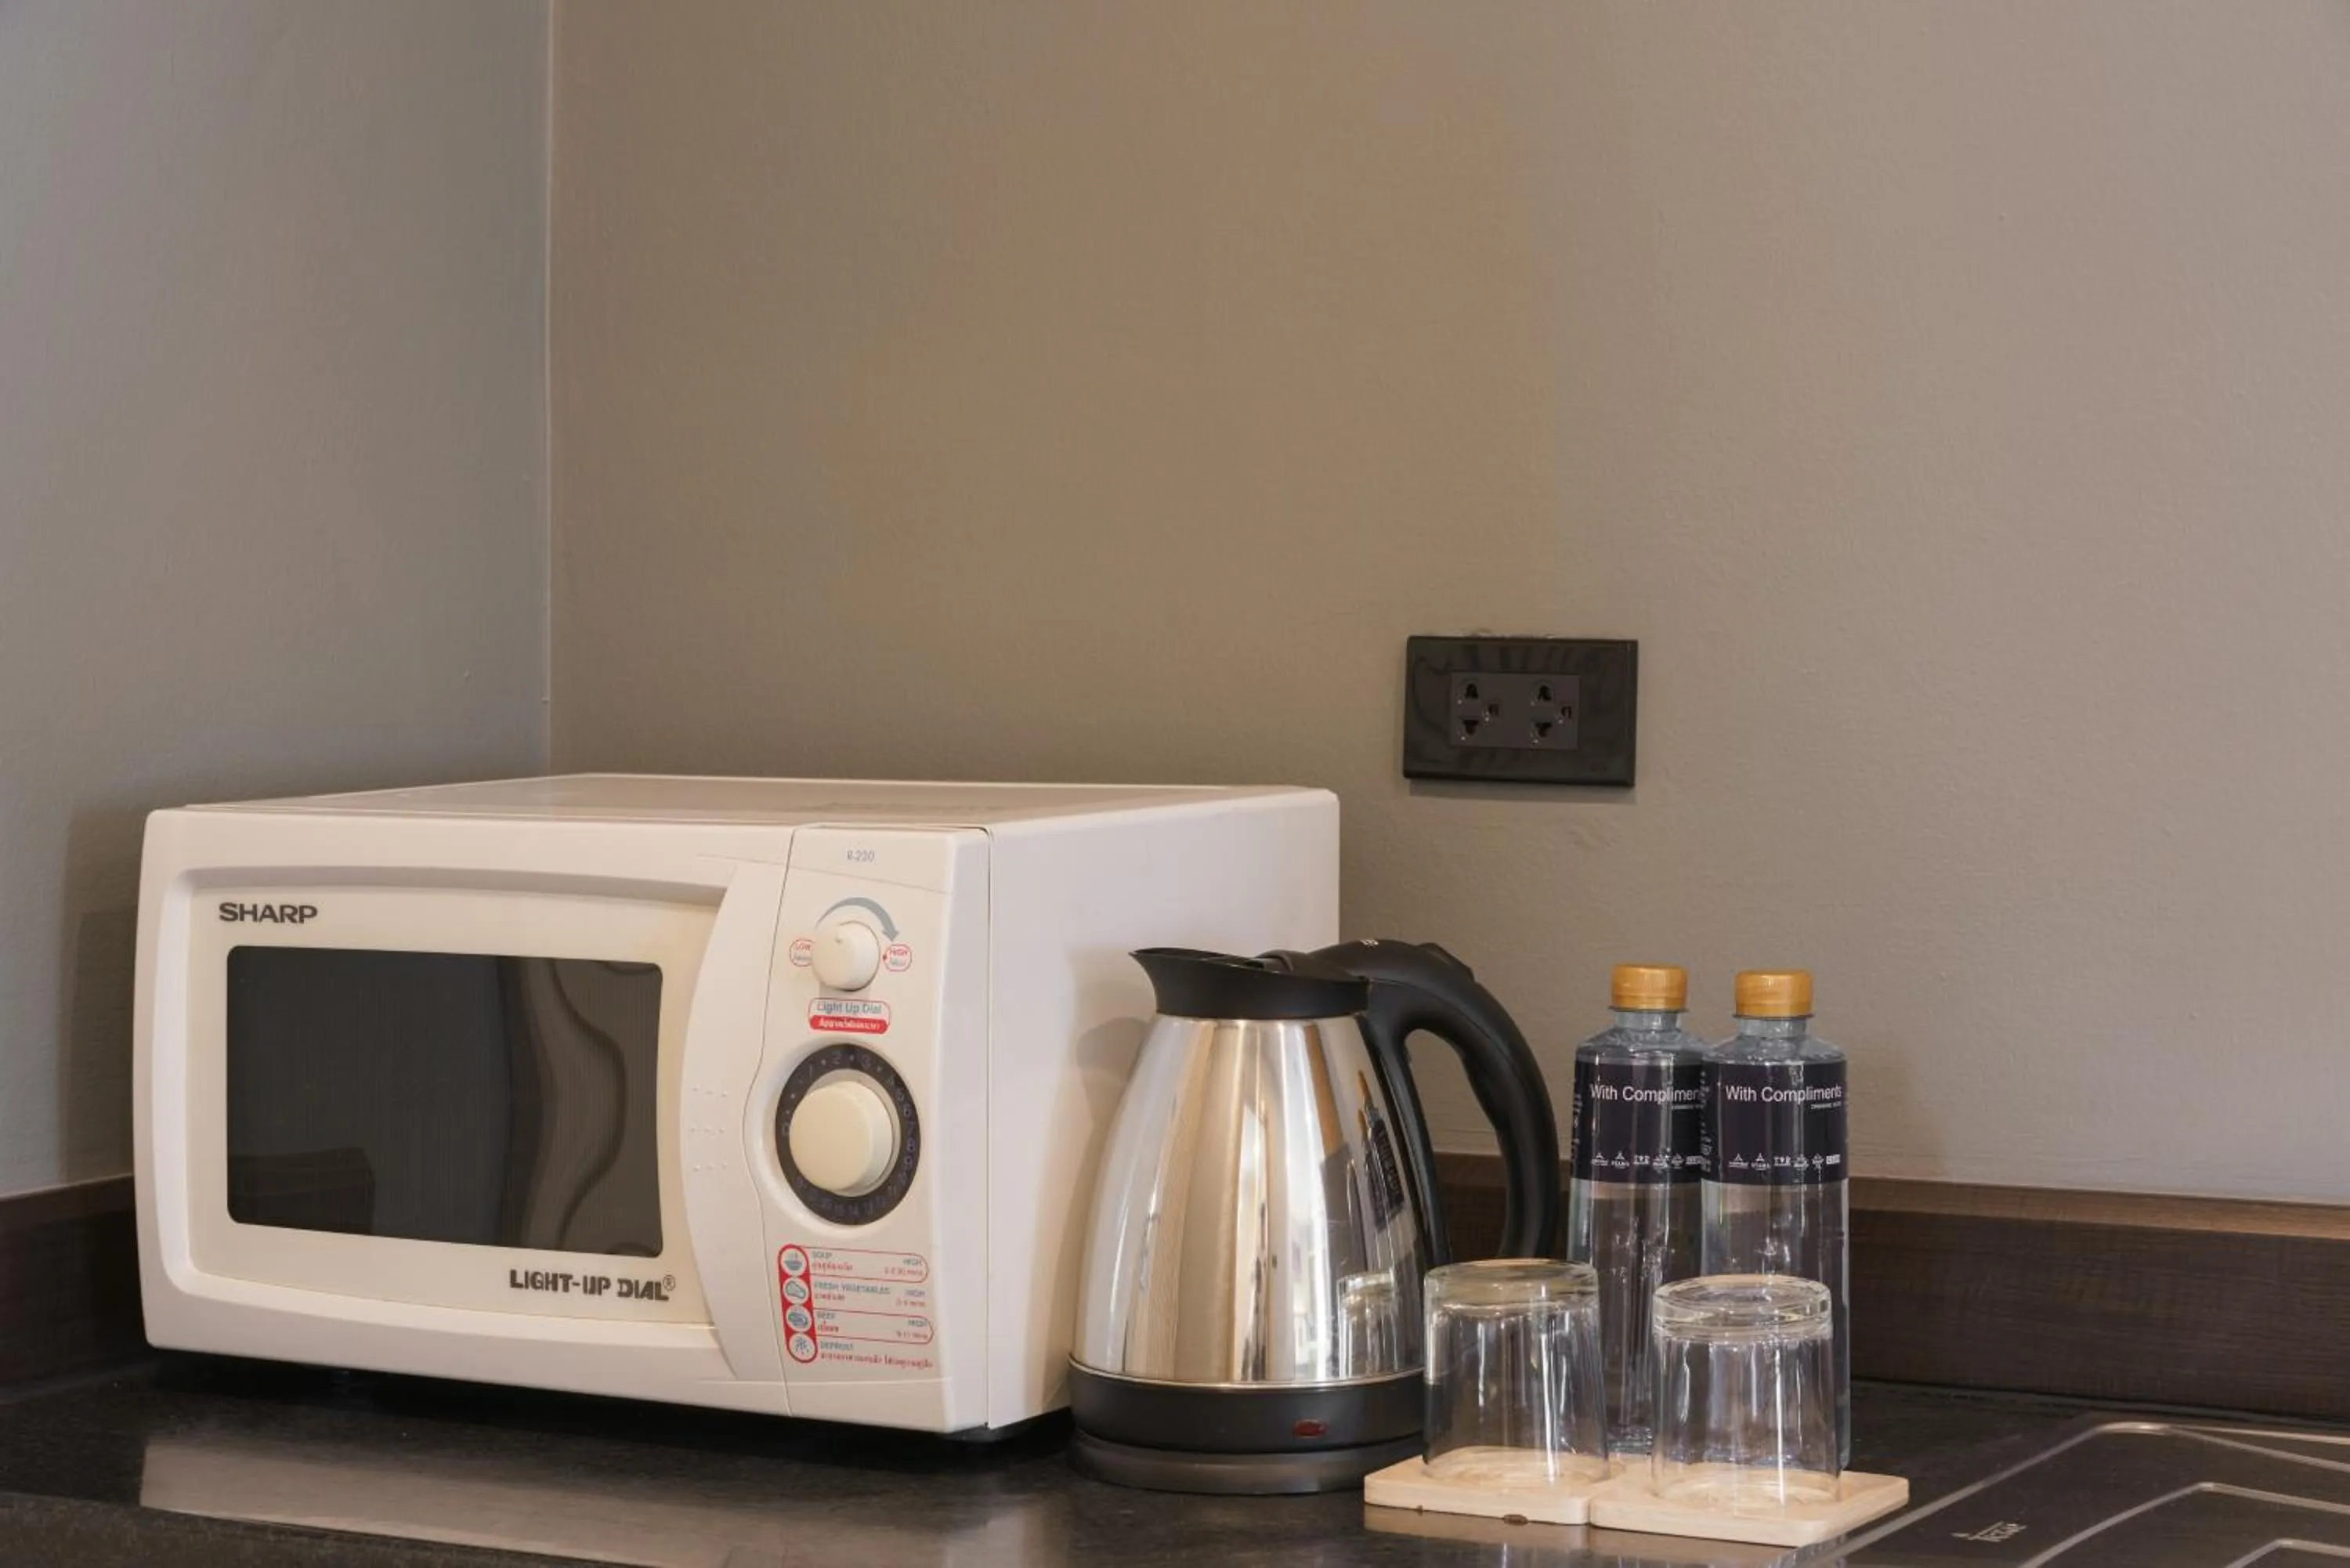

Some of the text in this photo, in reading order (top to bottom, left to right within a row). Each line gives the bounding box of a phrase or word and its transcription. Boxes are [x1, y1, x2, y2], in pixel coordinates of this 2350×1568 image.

[219, 901, 318, 924] SHARP
[817, 1001, 882, 1015] Light Up Dial
[1590, 1084, 1618, 1100] With
[1726, 1084, 1842, 1104] With Compliments
[509, 1269, 612, 1296] LIGHT-UP
